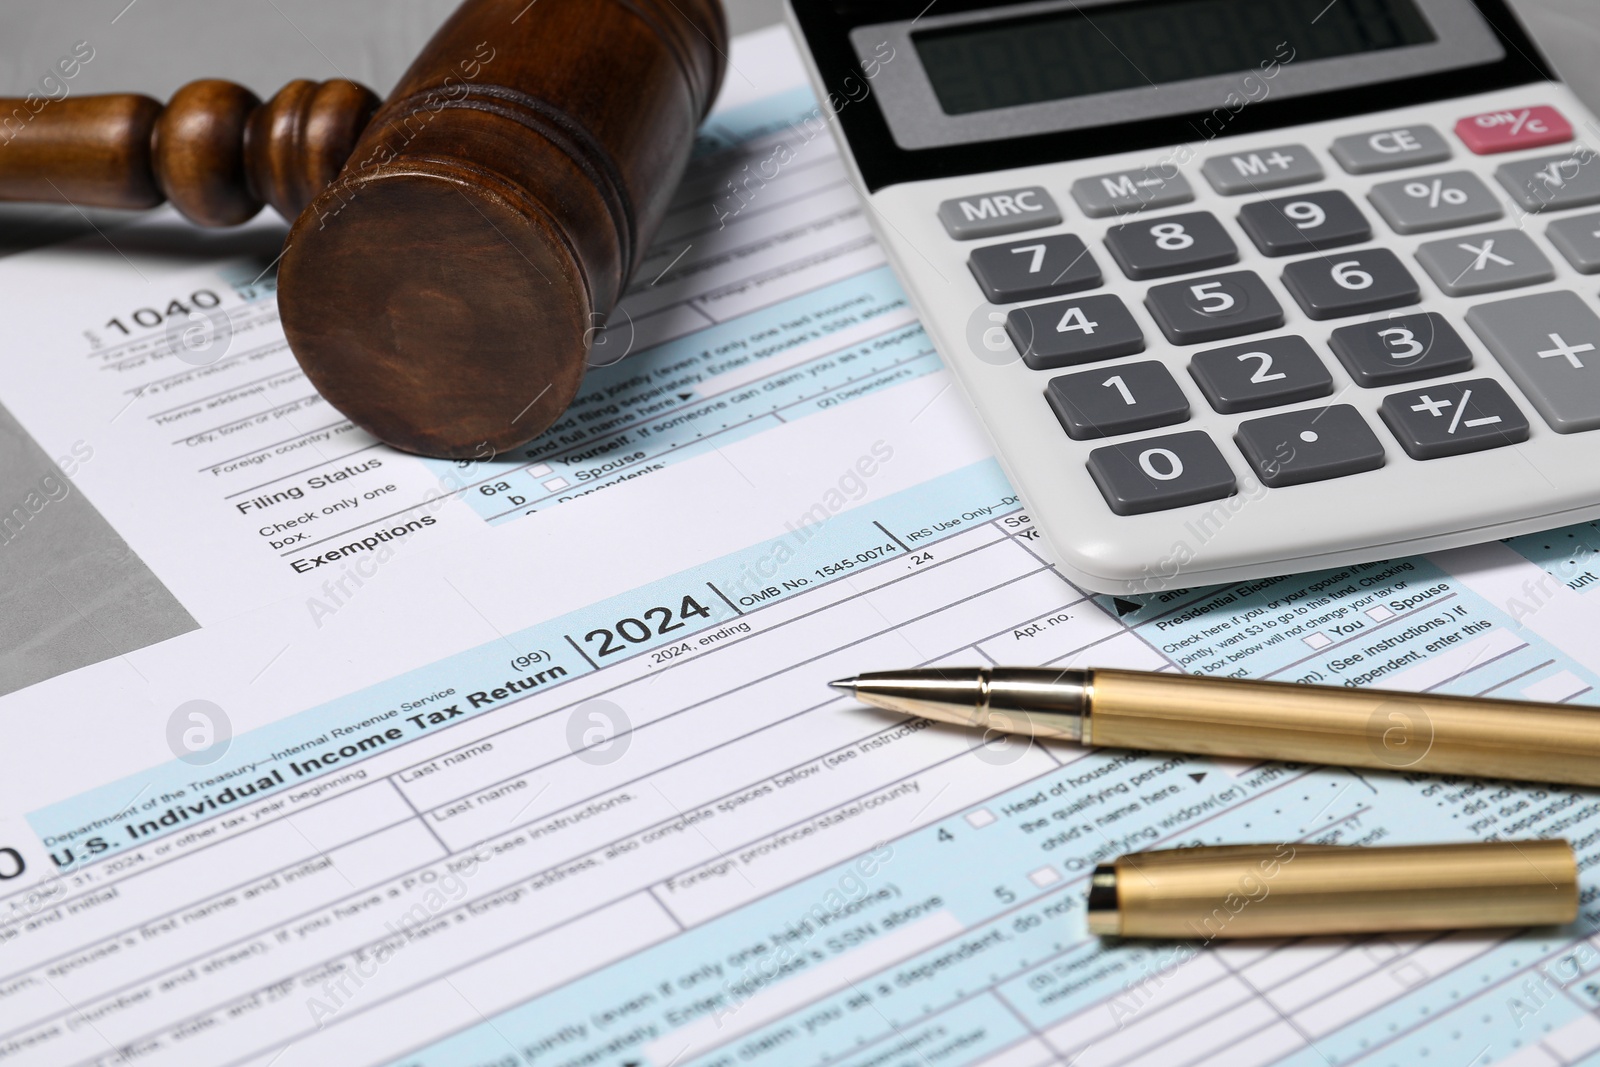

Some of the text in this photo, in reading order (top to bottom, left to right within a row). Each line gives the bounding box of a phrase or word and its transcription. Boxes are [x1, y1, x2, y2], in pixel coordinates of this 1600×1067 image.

[1230, 151, 1295, 177] M+
[1368, 129, 1422, 154] CE
[958, 190, 1044, 221] MRC
[1283, 200, 1327, 229] 9
[1403, 178, 1469, 209] %
[1010, 244, 1047, 274] 7
[1150, 222, 1195, 251] 8
[1189, 281, 1235, 313] 5
[1330, 260, 1374, 290] 6
[105, 289, 222, 336] 1040
[1055, 306, 1099, 335] 4
[1377, 328, 1424, 359] 3
[1101, 375, 1137, 406] 1
[1236, 351, 1287, 384] 2
[578, 401, 621, 423] filing
[620, 373, 704, 408] separately.
[478, 360, 837, 497] 6a Yourself. If someone can claim you
[525, 395, 677, 459] and full name here
[211, 430, 331, 477] Foreign country
[1138, 448, 1184, 481] 0
[236, 457, 383, 516] Filing Status
[507, 494, 527, 506] b
[573, 449, 647, 483] Spouse
[258, 483, 397, 538] Check only one
[906, 517, 962, 543] IRS Use
[269, 533, 312, 550] box.
[290, 513, 437, 574] Exemptions
[911, 551, 935, 567] 24
[739, 542, 898, 607] OMB No. 1545-0074
[510, 594, 711, 672] (99) 2024
[1013, 612, 1075, 641] Apt. no.
[1156, 591, 1239, 632] Presidential
[1162, 568, 1351, 655] Check here if you, or your spouse
[1180, 561, 1415, 668] jointly, want $3 to go to this fund. Checking
[1202, 580, 1408, 673] box below will not change your tax or
[1328, 582, 1450, 638] You Spouse
[652, 621, 752, 665] 2024, ending
[1326, 605, 1468, 674] (See instructions.) If
[1344, 650, 1428, 688] dependent,
[1425, 633, 1463, 653] enter
[1462, 617, 1492, 636] this
[42, 805, 139, 848] Department
[143, 796, 162, 812] of
[161, 789, 187, 806] the
[331, 708, 399, 740] Revenue
[400, 685, 457, 713] Service
[50, 664, 570, 868] U.S. Individual Income Tax Return
[288, 767, 369, 802] beginning
[399, 742, 495, 785] Last name
[431, 778, 528, 822] Last name
[641, 749, 858, 846] complete spaces below (see
[936, 781, 1069, 843] 4 Head of
[1018, 756, 1186, 835] the qualifying person
[1040, 783, 1187, 853] child's name here.
[664, 779, 922, 894] Foreign province/state/county
[994, 780, 1248, 907] 5 Qualifying widow(er)
